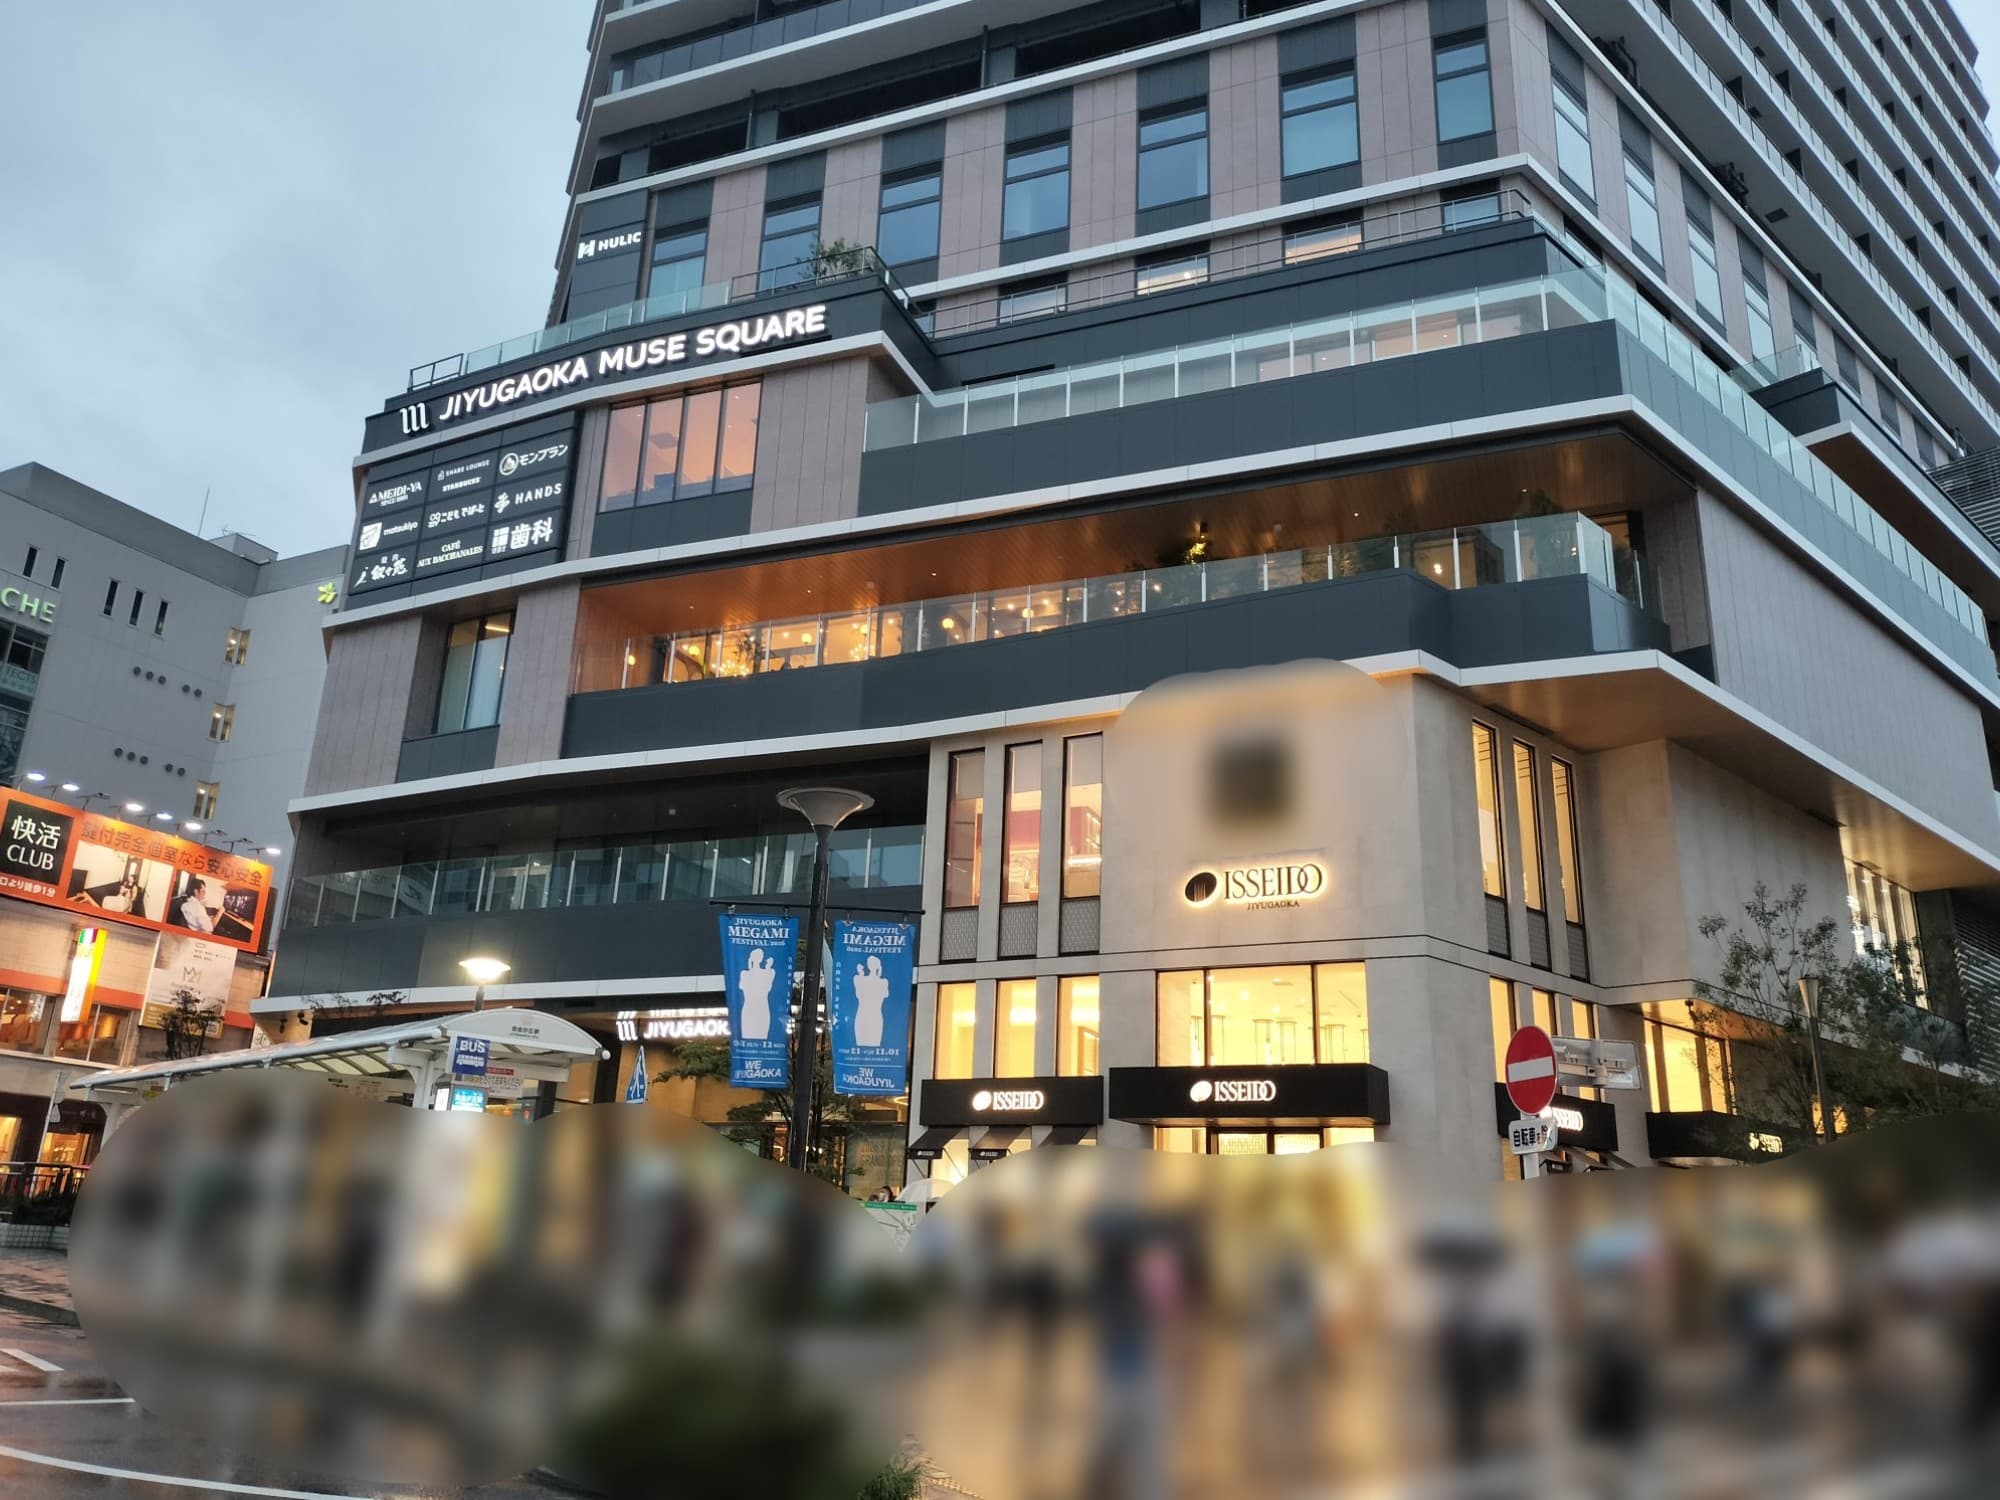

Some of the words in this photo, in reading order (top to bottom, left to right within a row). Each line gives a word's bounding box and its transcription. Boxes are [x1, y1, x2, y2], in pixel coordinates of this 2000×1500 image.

[598, 231, 642, 251] HULIC
[439, 357, 589, 421] JIYUGAOKA
[599, 334, 687, 374] MUSE
[695, 305, 826, 355] SQUARE
[442, 477, 481, 492] STARBUCKS
[515, 483, 562, 504] HANDS
[510, 516, 553, 549] 歯科
[11, 815, 61, 850] 快活
[7, 844, 54, 870] CLUB
[1224, 863, 1322, 900] ISSEIDO
[1247, 900, 1300, 910] JIYUGAOKA
[734, 917, 783, 926] JIYUGAOKA
[728, 926, 790, 939] MEGAMI
[732, 938, 769, 946] FESTIVAL
[643, 1019, 731, 1039] JIYUGAOK
[459, 1040, 486, 1053] BUS
[745, 1060, 762, 1070] WE
[992, 1090, 1045, 1111] ISSEIDO
[1214, 1080, 1276, 1102] ISSEIDO
